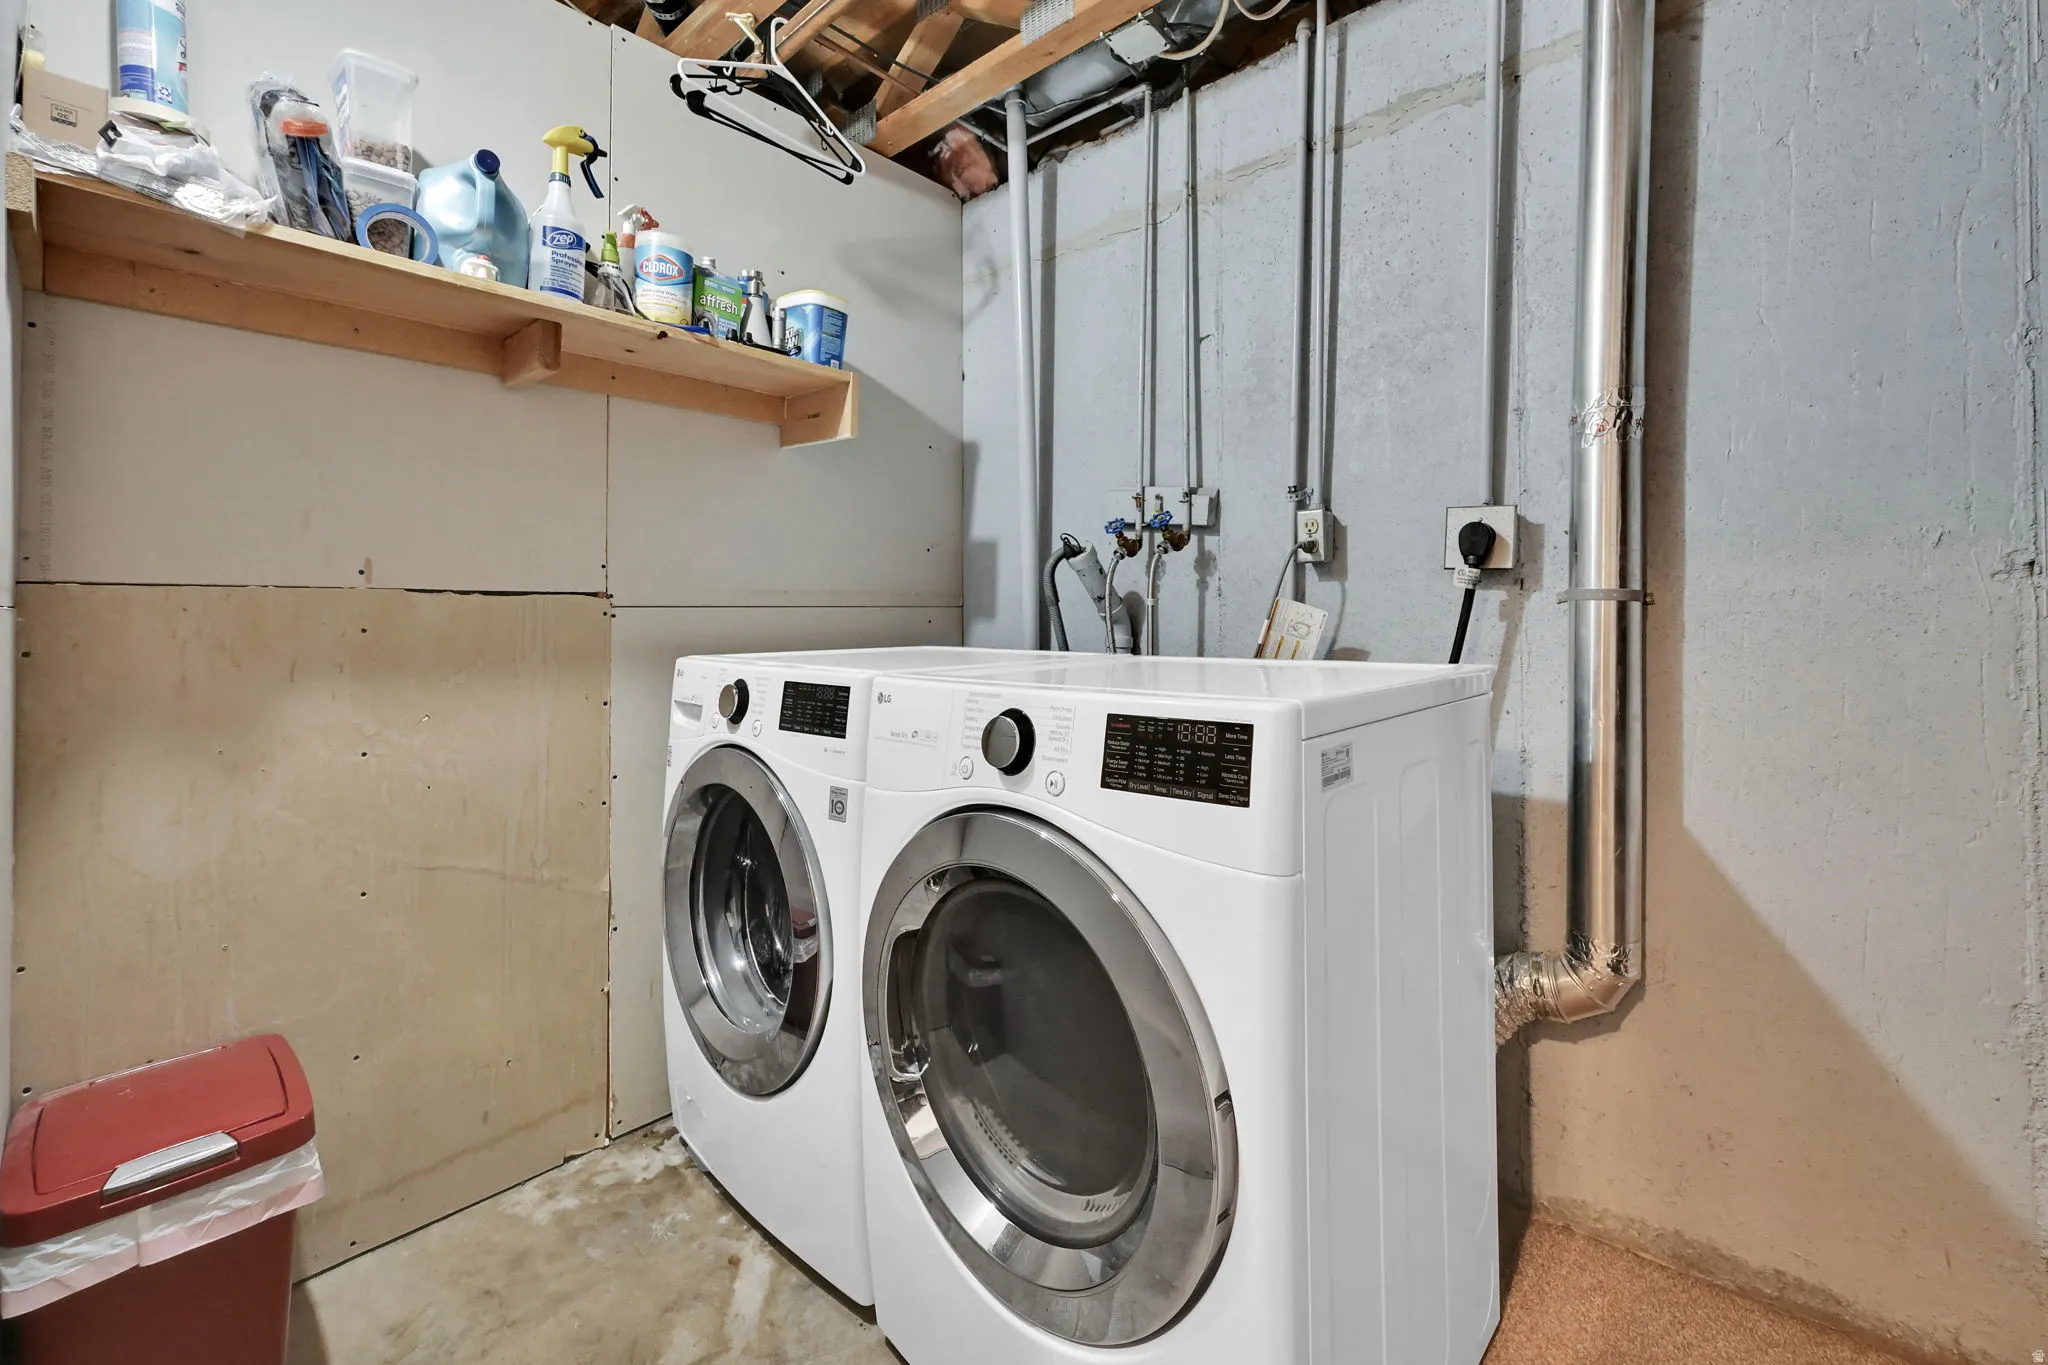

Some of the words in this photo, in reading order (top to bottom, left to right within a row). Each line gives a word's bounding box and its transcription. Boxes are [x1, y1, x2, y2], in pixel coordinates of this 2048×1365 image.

[551, 256, 578, 269] Sprayer
[642, 261, 679, 277] CLOROX
[700, 293, 738, 315] affresh
[1153, 785, 1168, 793] Temp.
[1172, 787, 1184, 795] Time
[1197, 791, 1214, 800] Signal
[831, 799, 845, 816] 10
